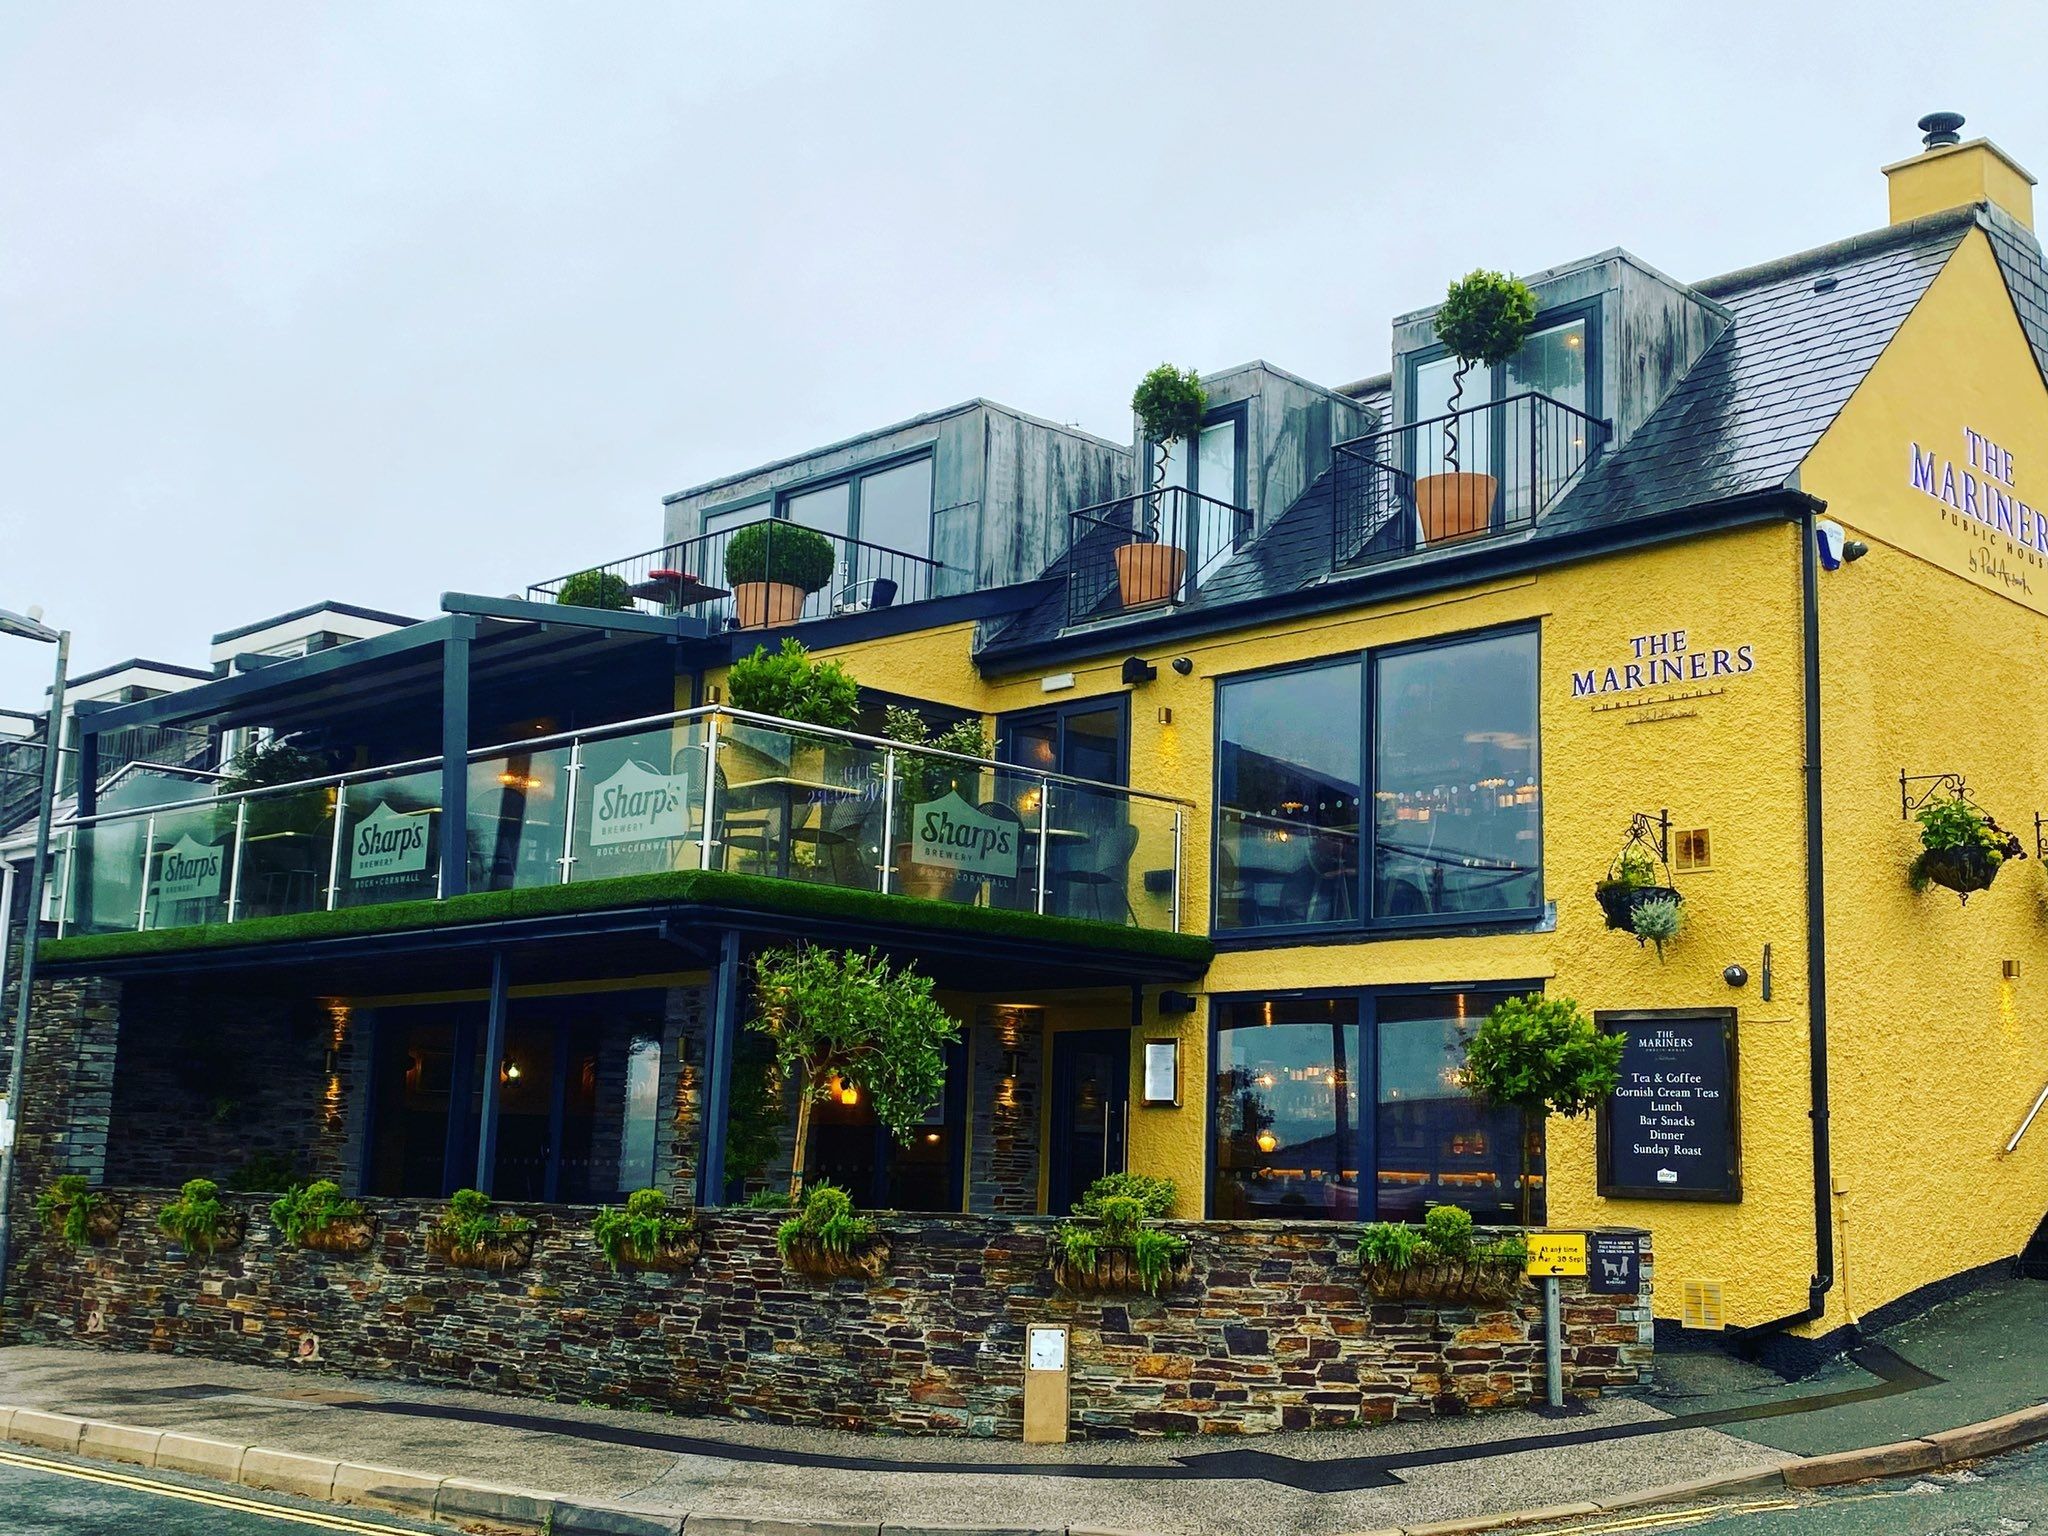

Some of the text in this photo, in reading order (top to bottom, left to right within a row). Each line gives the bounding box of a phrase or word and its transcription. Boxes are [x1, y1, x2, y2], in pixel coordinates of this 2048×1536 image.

[1963, 426, 2016, 488] THE
[1941, 508, 2048, 570] PUBLIC HOUS
[1630, 630, 1687, 658] THE
[1571, 645, 1754, 697] MARINERS
[599, 782, 681, 825] Sharp's
[602, 822, 643, 836] BREWERY
[920, 811, 1011, 860] Sharp's
[358, 822, 423, 860] Sharp's
[597, 839, 675, 857] ROCK CORNWA
[925, 847, 973, 862] BREWERY
[165, 852, 218, 887] Sharp's
[380, 873, 420, 886] CORNWALL
[1656, 1030, 1674, 1039] THE
[1638, 1038, 1694, 1048] MARINERS
[1631, 1073, 1702, 1083] Tea & Coffee
[1615, 1087, 1720, 1098] Cornish Cream Teas
[1651, 1101, 1682, 1112] Lunch
[1640, 1115, 1695, 1127] Bar Snacks
[1650, 1130, 1685, 1140] Dinner
[1633, 1144, 1702, 1157] Sunday Roast
[1541, 1245, 1578, 1254] At any time
